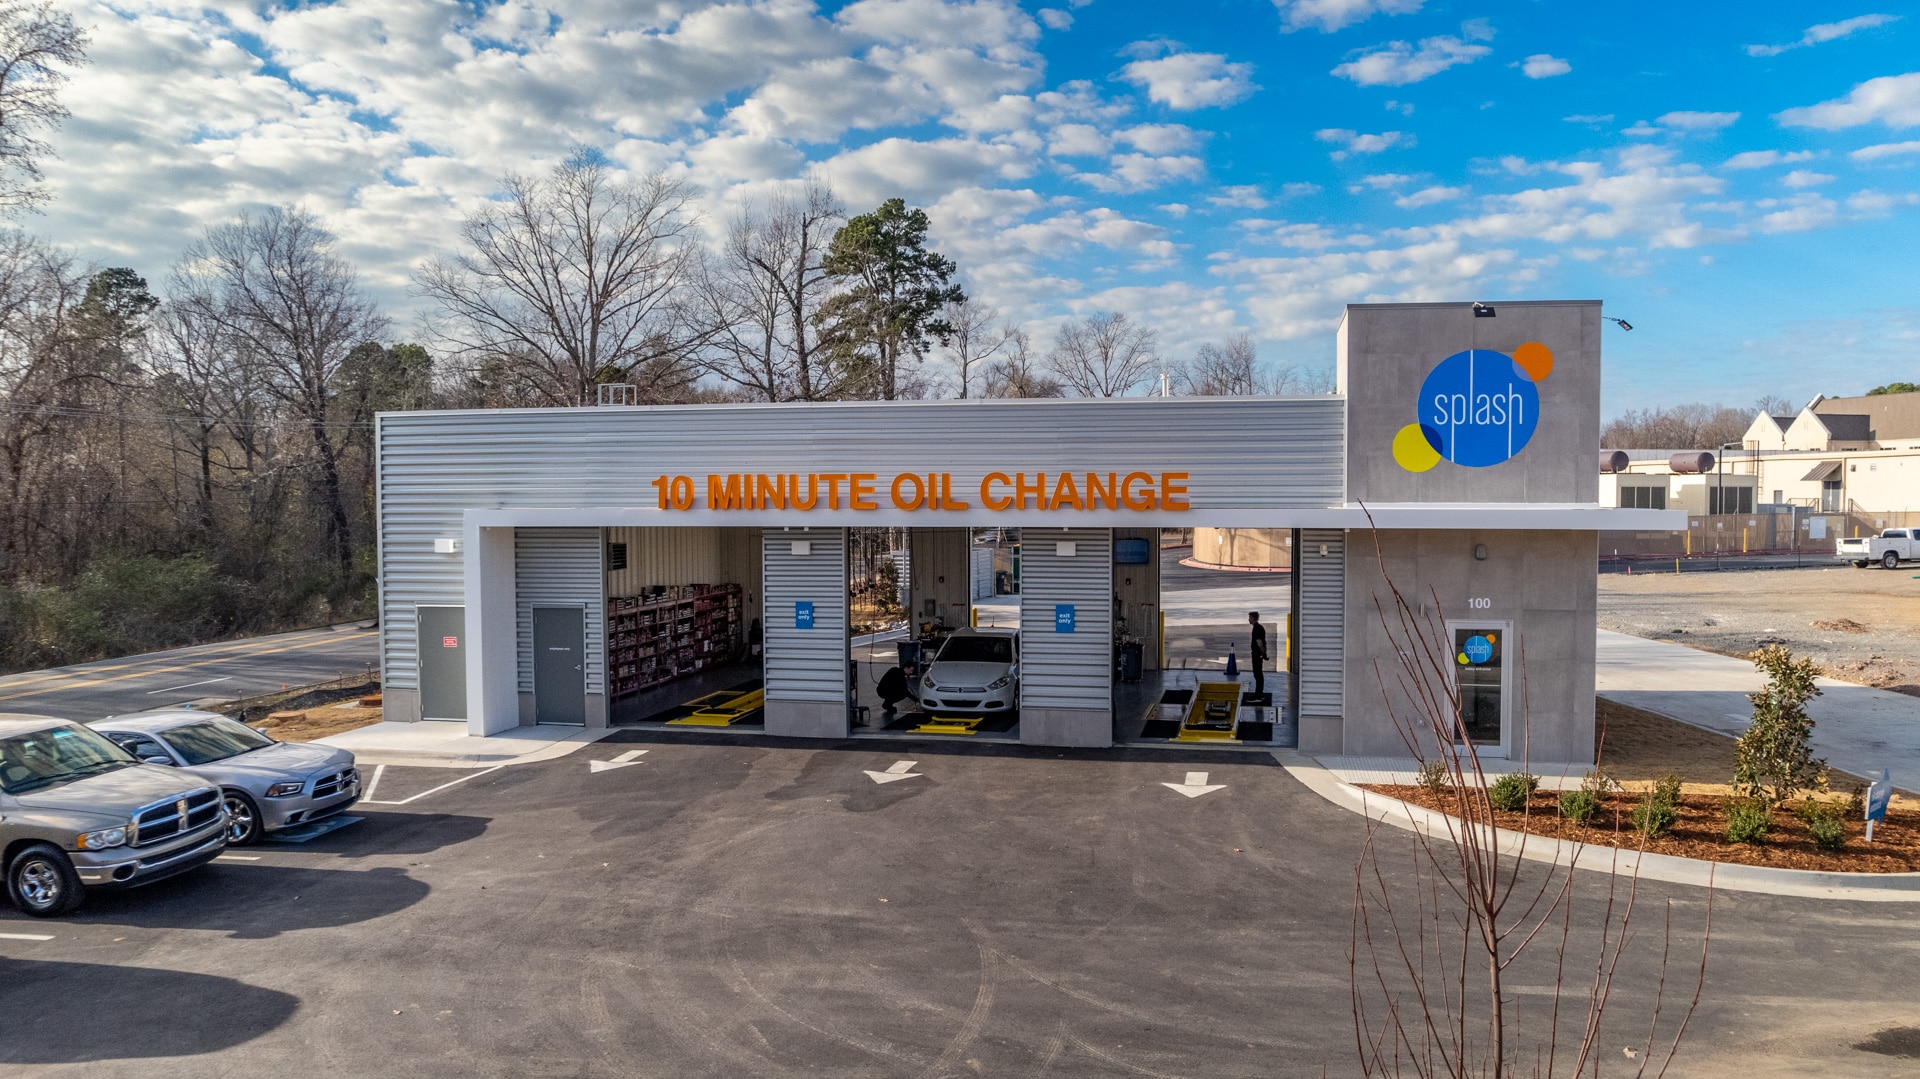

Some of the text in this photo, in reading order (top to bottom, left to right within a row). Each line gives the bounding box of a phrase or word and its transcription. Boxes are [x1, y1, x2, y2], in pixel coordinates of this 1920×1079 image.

[1434, 349, 1523, 463] splash
[652, 472, 1191, 511] 10 MINUTE OIL CHANGE
[1468, 598, 1491, 608] 100
[1467, 636, 1489, 662] splash
